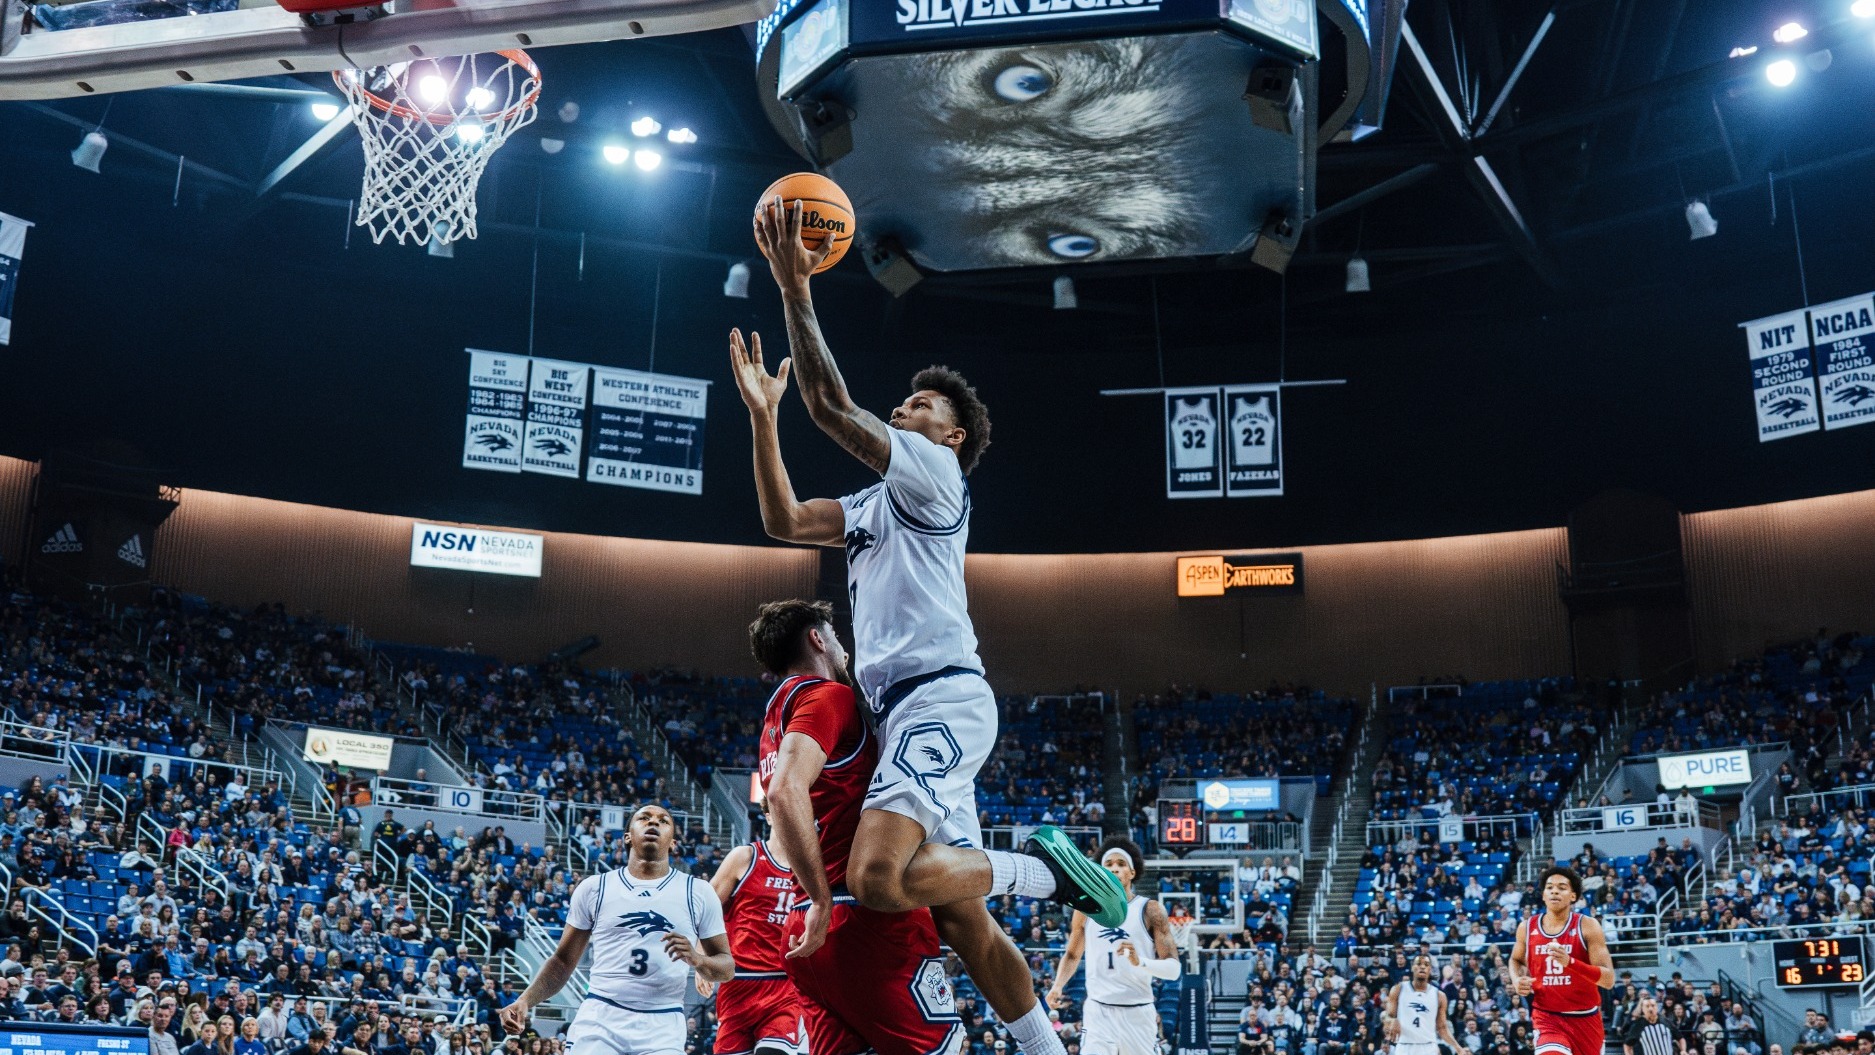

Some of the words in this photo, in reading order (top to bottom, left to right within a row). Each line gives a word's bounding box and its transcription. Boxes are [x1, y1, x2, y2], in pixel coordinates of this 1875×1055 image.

[1815, 308, 1873, 338] NCAA
[1760, 324, 1795, 350] NIT
[1832, 337, 1860, 352] 1984
[1767, 352, 1794, 366] 1979
[1829, 345, 1866, 362] FIRST
[493, 359, 507, 367] BIG
[1754, 358, 1809, 378] SECOND
[1827, 356, 1872, 374] ROUND
[492, 368, 507, 376] SKY
[551, 369, 568, 380] BIG
[1761, 370, 1803, 388] ROUND
[473, 375, 524, 387] CONFERENCE
[544, 380, 573, 392] WEST
[602, 378, 649, 391] WESTERN
[653, 385, 700, 399] ATHLETIC
[532, 390, 582, 404] CONFERENCE
[618, 394, 682, 409] CONFERENCE
[1760, 385, 1812, 408] NEVADA
[471, 407, 521, 418] CHAMPIONS
[528, 412, 582, 426] CHAMPIONS
[470, 422, 519, 440] NEVADA
[1762, 416, 1817, 434] BASKETBALL
[529, 427, 577, 445] NEVADA
[1182, 429, 1206, 449] 32
[1242, 427, 1265, 447] 22
[467, 454, 519, 466] BASKETBALL
[525, 457, 576, 470] BASKETBALL
[595, 464, 695, 487] CHAMPIONS
[1177, 472, 1212, 483] JONES
[41, 541, 83, 553] adidas
[421, 531, 477, 552] NSN
[481, 536, 534, 550] NEVADA
[481, 546, 534, 558] SPORTSNET
[1187, 564, 1220, 588] ASPEN
[1224, 562, 1295, 588] EARTHWORKS
[336, 739, 367, 749] LOCAL
[1686, 756, 1743, 775] PURE
[451, 790, 471, 807] 10
[1616, 810, 1635, 825] 16
[1167, 818, 1196, 841] 28
[1220, 825, 1238, 840] 14
[1444, 824, 1458, 836] 15
[629, 948, 649, 976] 3
[1108, 952, 1114, 969] 1
[1542, 975, 1572, 986] STATE
[1785, 967, 1802, 984] 16
[1841, 964, 1863, 982] 23
[1412, 1016, 1420, 1028] 4
